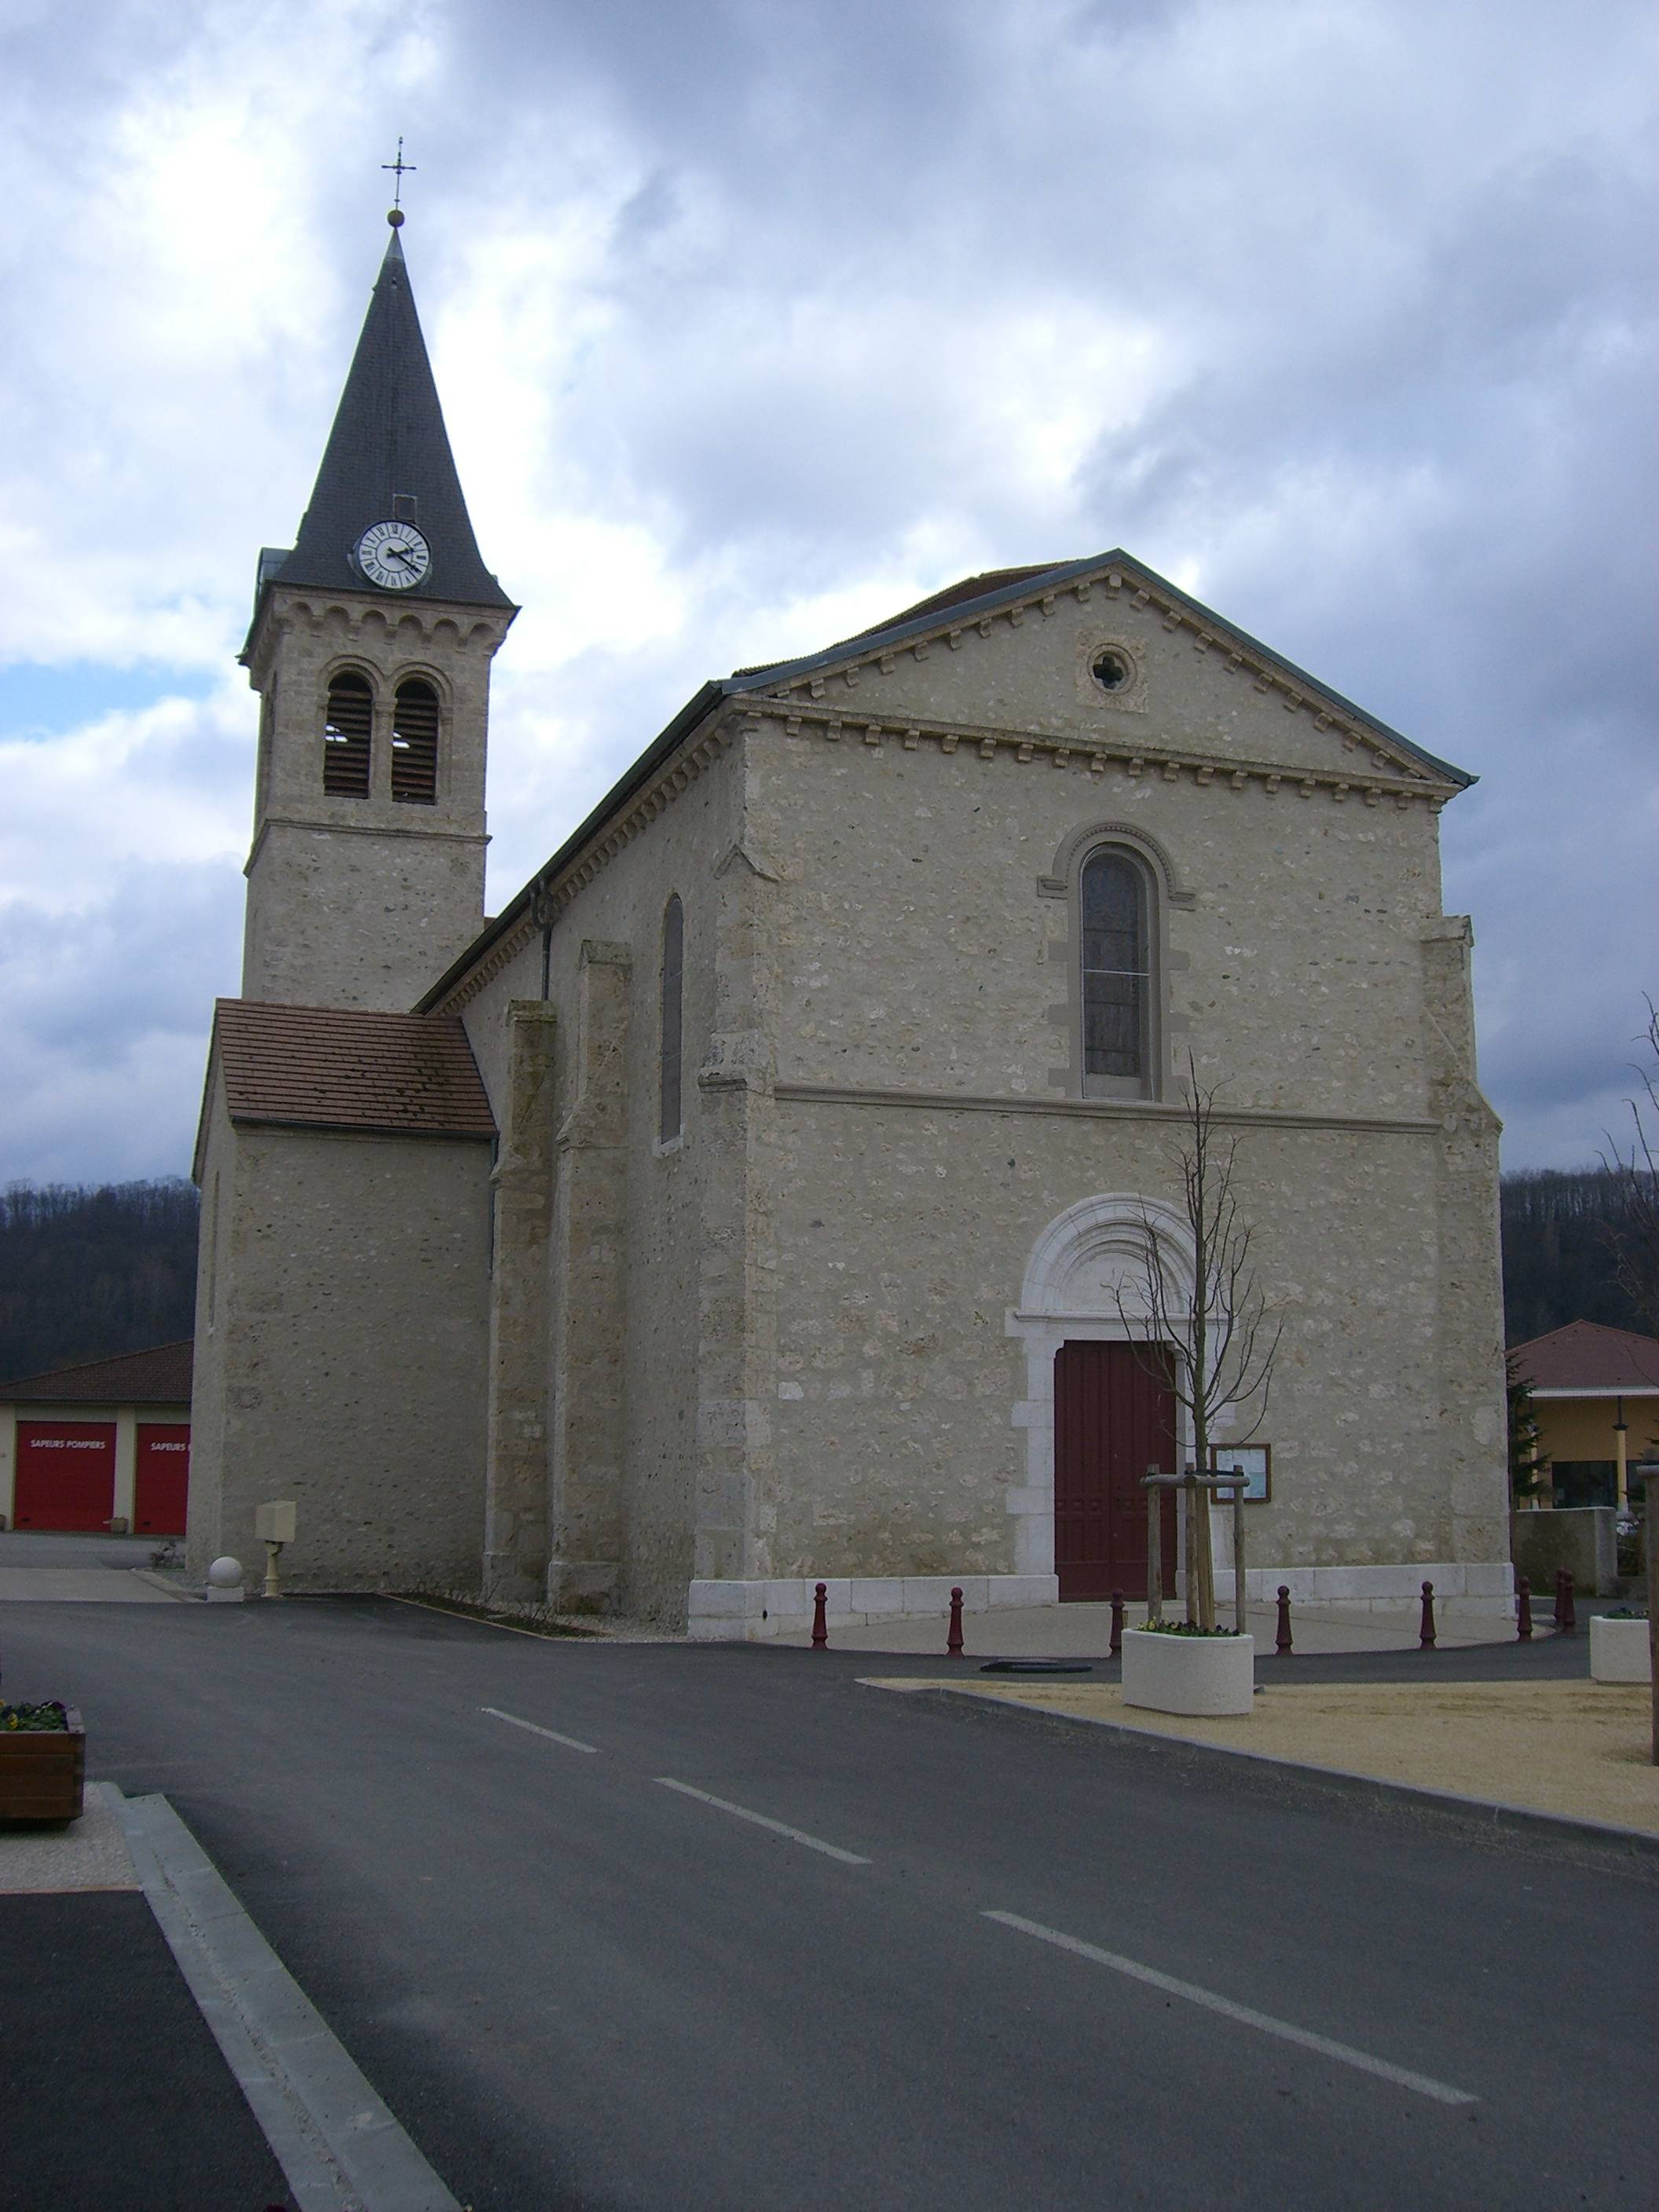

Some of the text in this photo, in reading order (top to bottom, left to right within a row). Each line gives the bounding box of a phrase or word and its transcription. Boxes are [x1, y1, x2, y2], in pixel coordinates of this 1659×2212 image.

[31, 1439, 106, 1449] SAPEURS POMPIERS
[151, 1442, 185, 1452] SAPEURS
